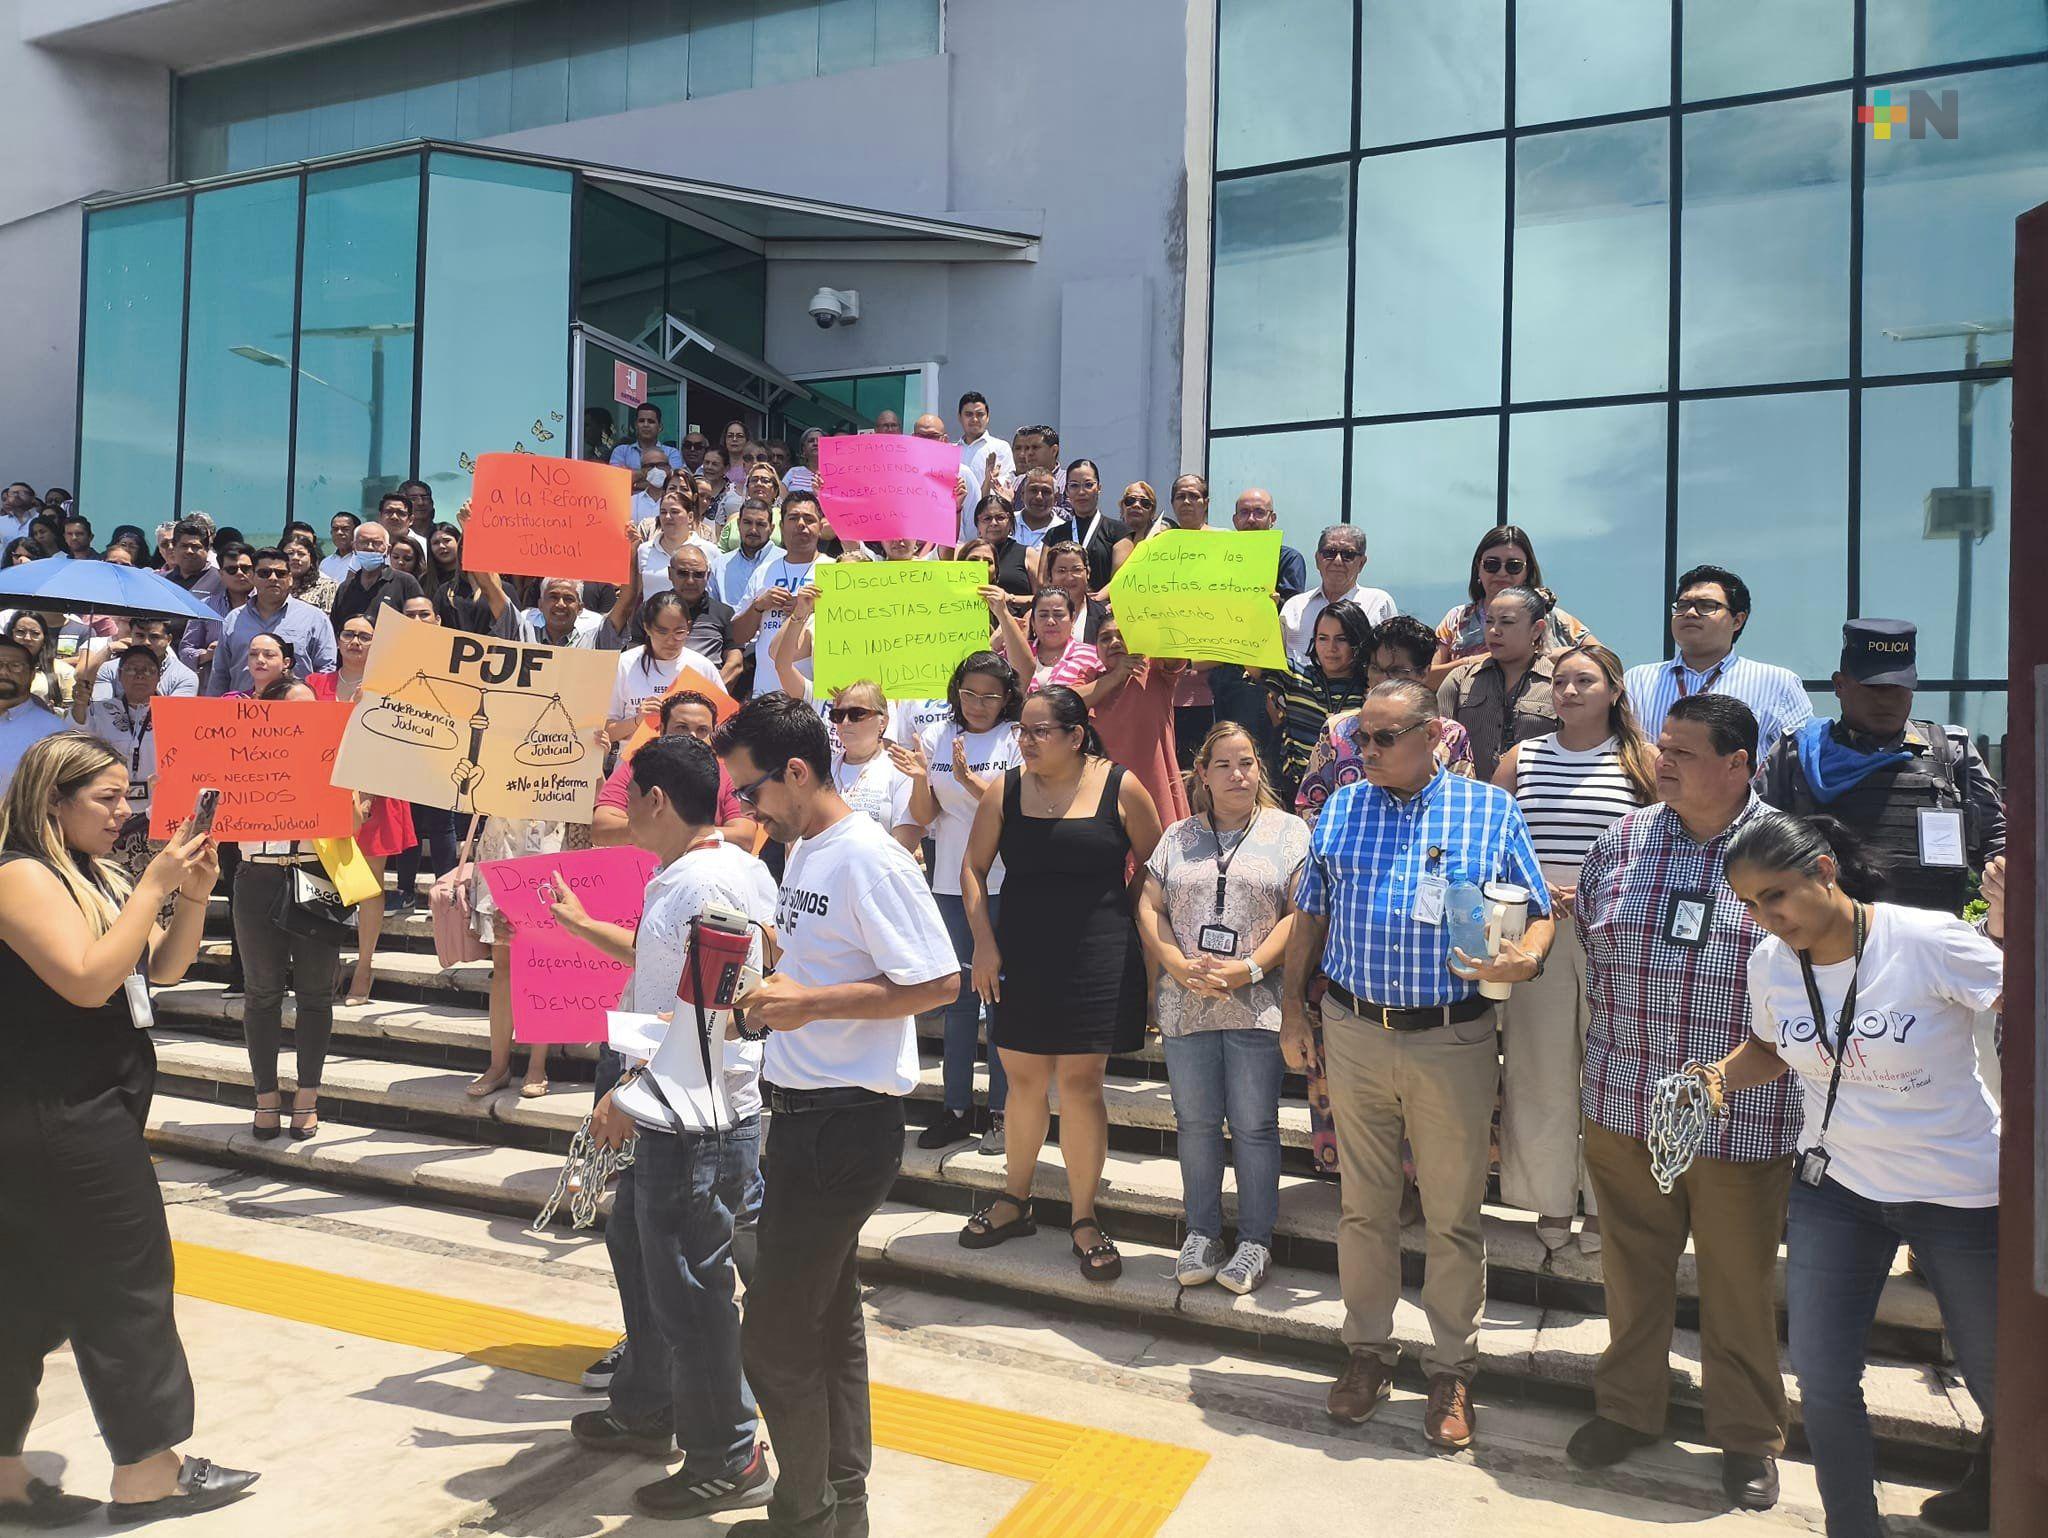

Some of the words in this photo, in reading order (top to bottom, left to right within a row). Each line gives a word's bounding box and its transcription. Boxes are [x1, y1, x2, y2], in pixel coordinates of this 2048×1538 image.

[835, 441, 908, 456] ESTAMOS
[530, 464, 570, 486] NO
[490, 488, 504, 505] a
[515, 486, 532, 507] la
[540, 488, 608, 511] Reforma
[827, 485, 938, 500] INDEPENDENCIA
[481, 505, 572, 529] Constitucional
[518, 533, 583, 558] Judicial
[1223, 550, 1244, 564] las
[947, 571, 981, 585] LAS
[1122, 570, 1201, 594] Molestias,
[1208, 577, 1268, 593] estamos
[827, 602, 932, 625] MOLESTIAS,
[1126, 604, 1215, 623] defendiendo
[1226, 608, 1244, 624] la
[828, 639, 852, 656] LA
[865, 629, 989, 655] INDEPENDENCIA
[1868, 641, 1909, 652] POLICIA
[449, 636, 553, 687] PJF
[237, 702, 272, 722] HOY
[194, 725, 237, 741] COMO
[251, 725, 305, 739] NUNCA
[391, 715, 435, 738] Judicial
[530, 730, 568, 743] Carrera
[231, 746, 290, 763] México
[530, 741, 572, 757] Judicial
[968, 762, 990, 773] OMOS
[191, 771, 217, 783] NOS
[224, 771, 292, 784] NECESITA
[506, 775, 531, 792] #No
[533, 779, 540, 788] a
[541, 776, 549, 790] la
[551, 773, 588, 791] Reforma
[532, 788, 576, 803] Judicial
[1776, 1016, 1818, 1048] YO
